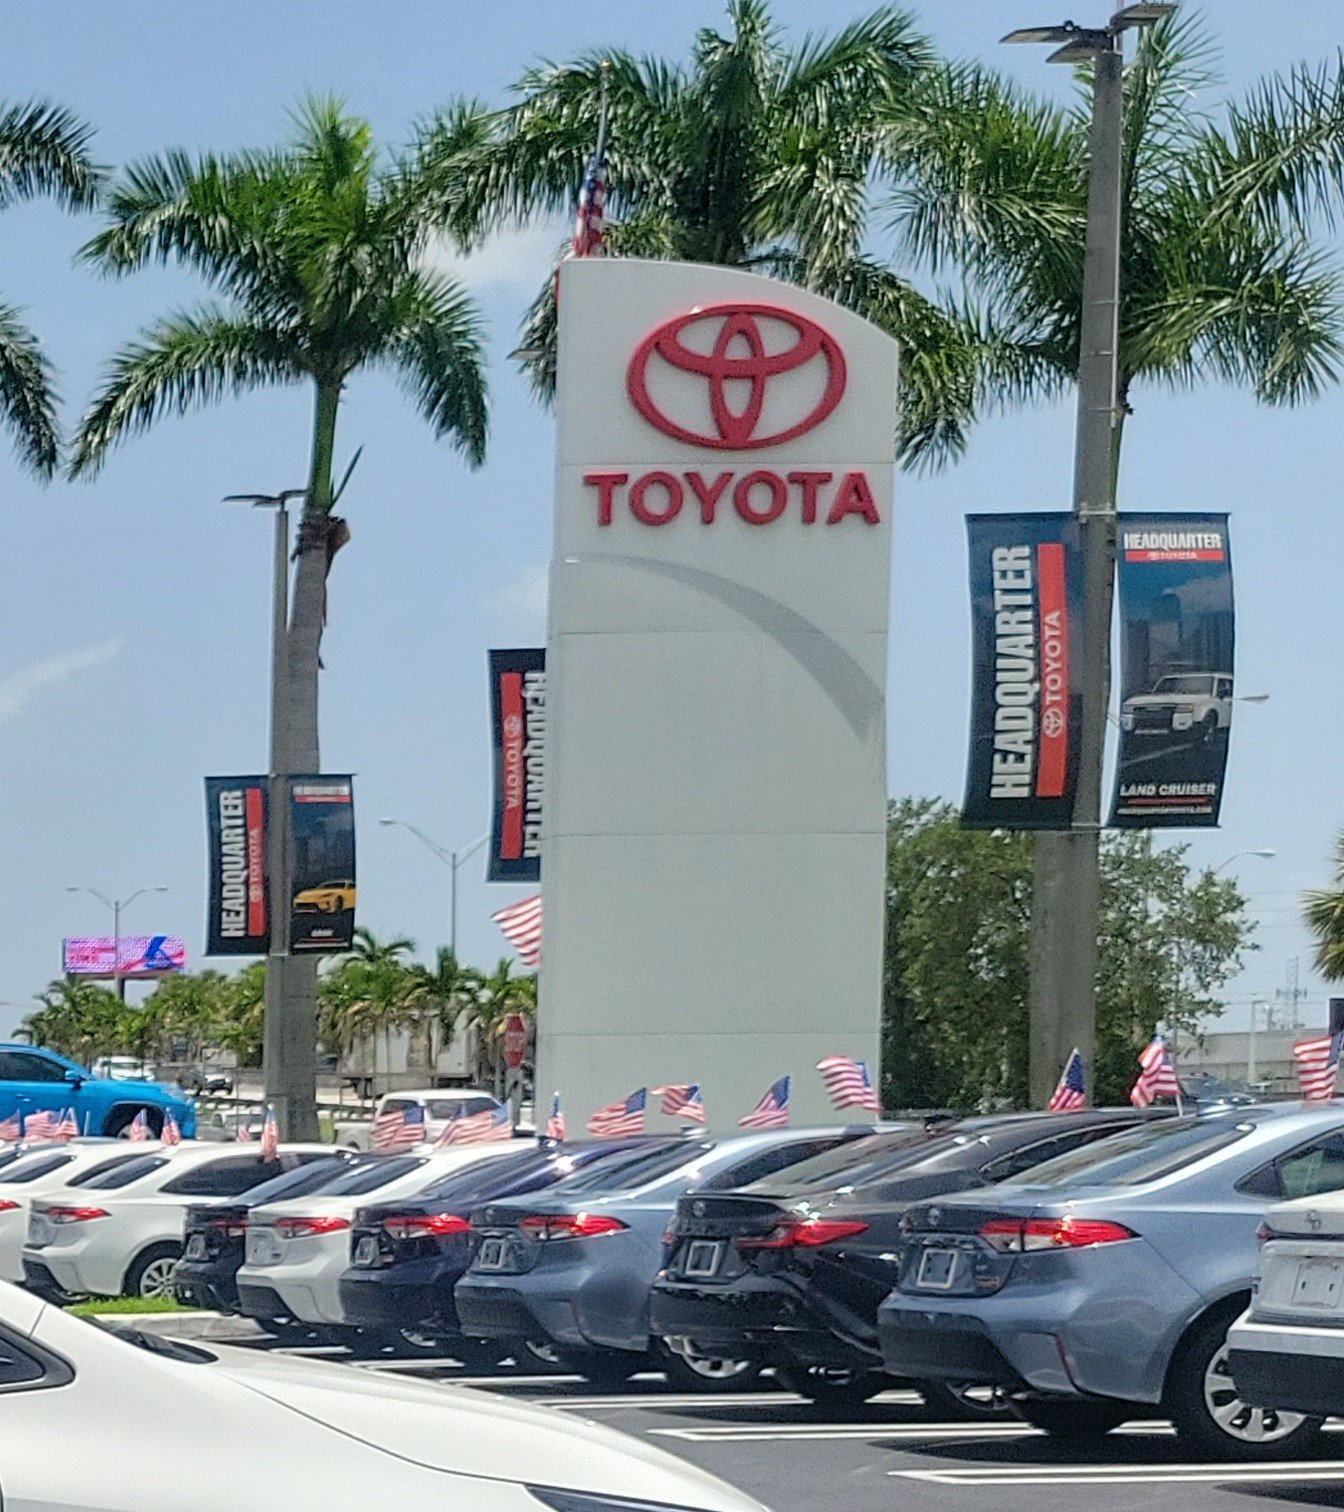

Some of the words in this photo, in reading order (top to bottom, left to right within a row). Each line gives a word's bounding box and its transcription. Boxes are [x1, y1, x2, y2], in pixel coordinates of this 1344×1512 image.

[583, 471, 881, 526] TOYOTA
[1124, 533, 1221, 550] HEADQUARTER
[990, 545, 1041, 797] HEADQUARTER
[1044, 611, 1061, 705] TOYOTA
[508, 742, 520, 809] TOYOTA
[1119, 783, 1156, 796] LAND
[1158, 782, 1216, 795] CRUISER
[220, 791, 247, 937] HEADQUARTER
